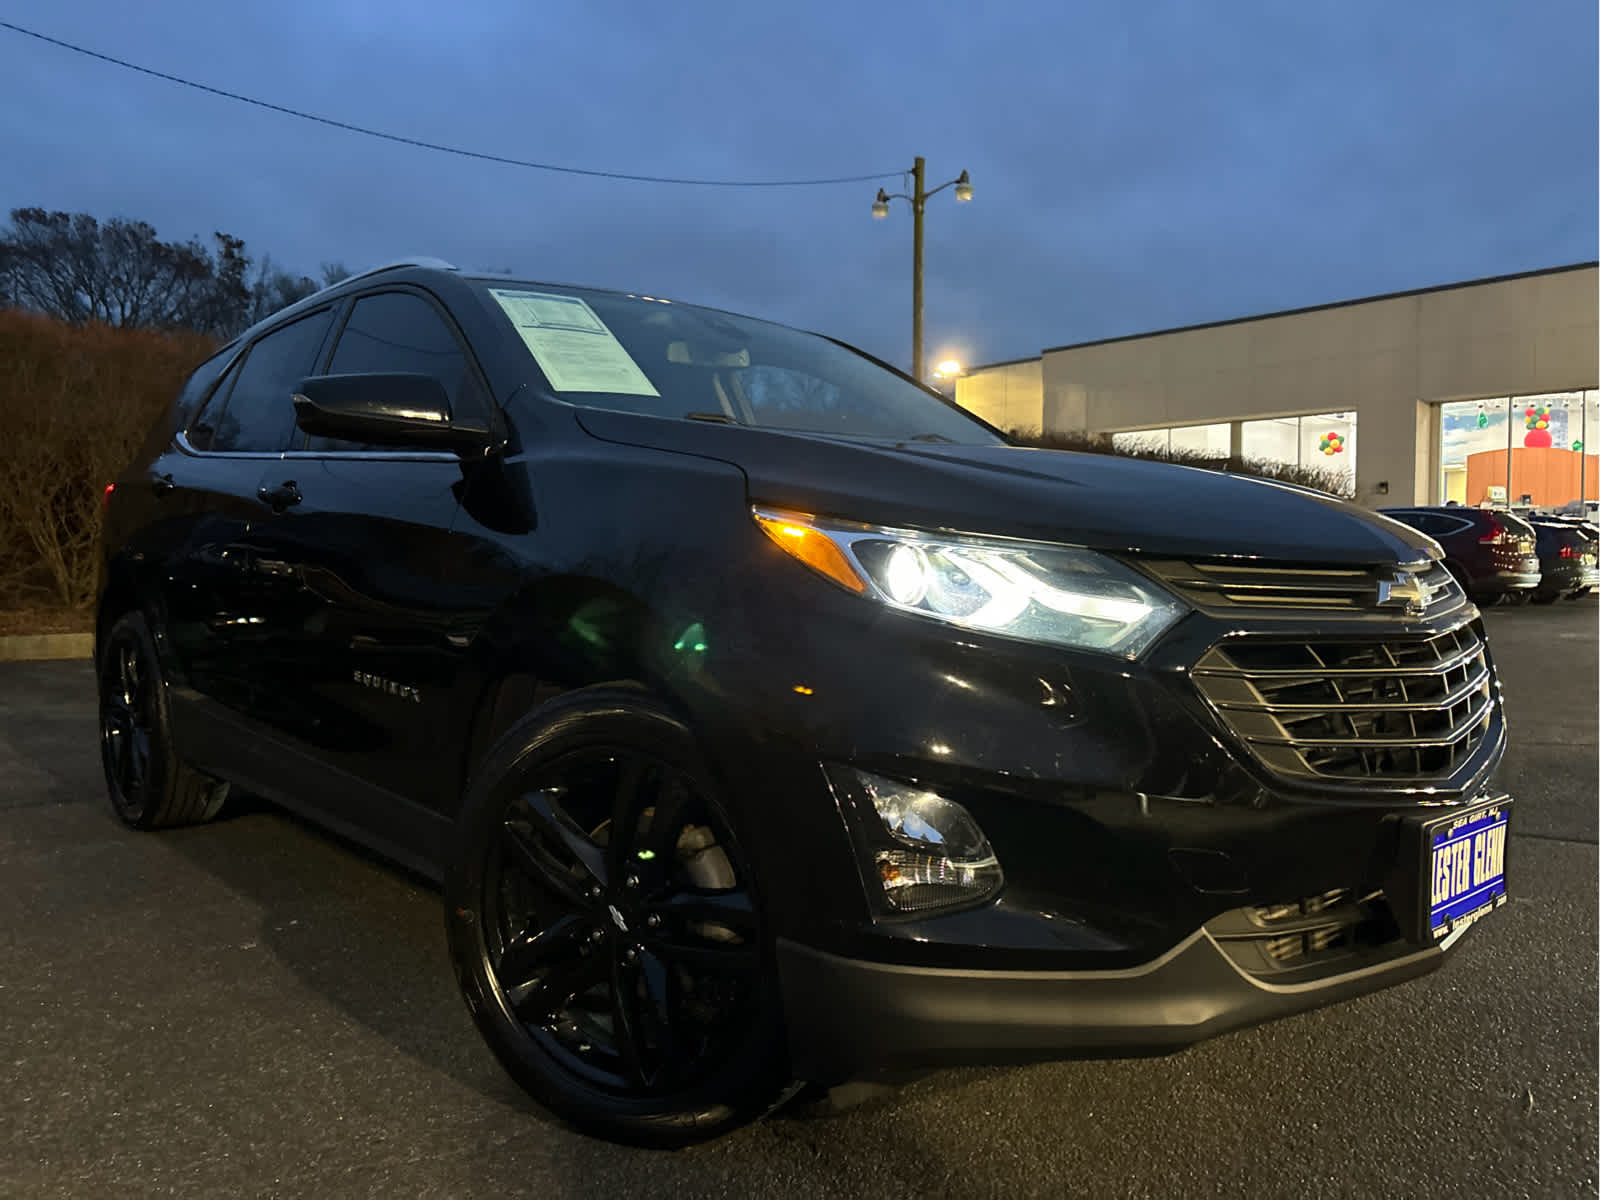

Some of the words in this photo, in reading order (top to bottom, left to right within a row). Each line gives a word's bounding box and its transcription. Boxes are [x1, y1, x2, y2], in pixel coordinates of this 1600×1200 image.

[1453, 816, 1468, 830] SEA
[1431, 838, 1471, 907] LESTER
[1473, 823, 1507, 887] GLENN
